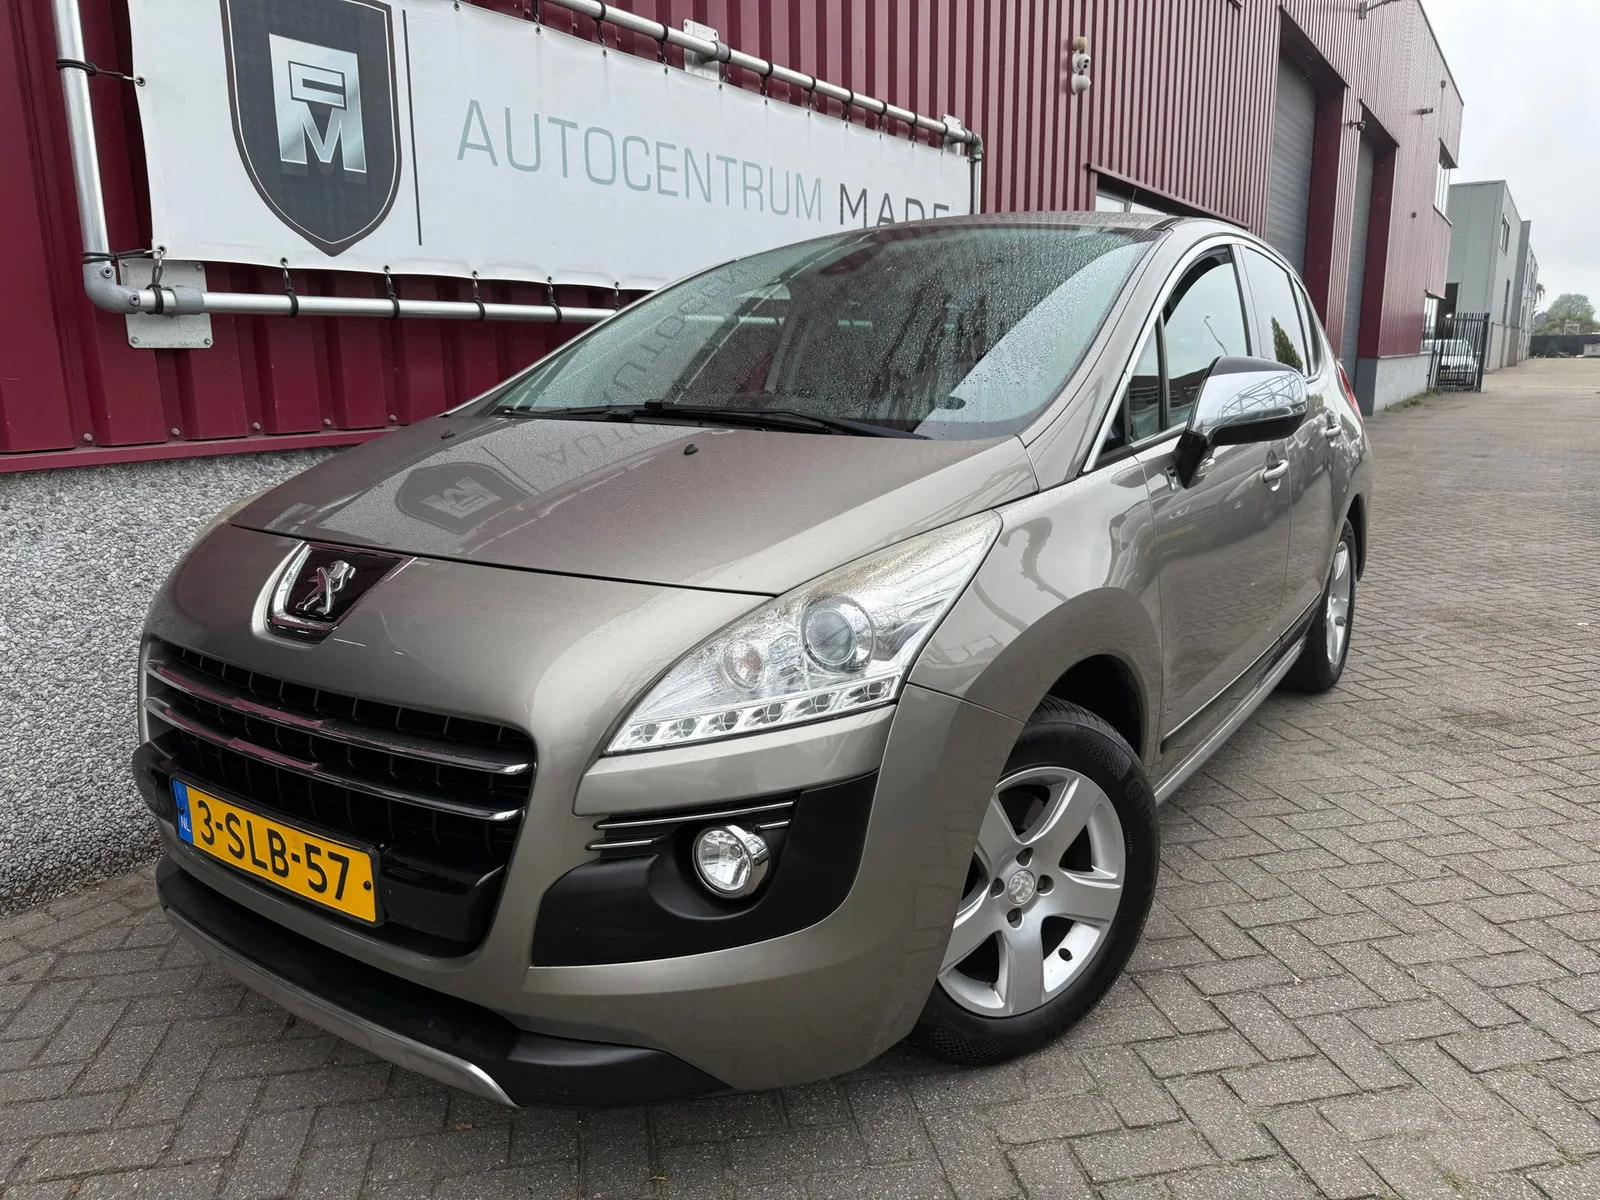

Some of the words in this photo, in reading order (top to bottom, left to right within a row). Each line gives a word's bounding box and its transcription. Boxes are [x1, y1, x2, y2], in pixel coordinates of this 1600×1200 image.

[456, 99, 822, 222] AUTOCENTRUM
[179, 815, 191, 832] NL
[197, 799, 350, 901] 3-SLB-57
